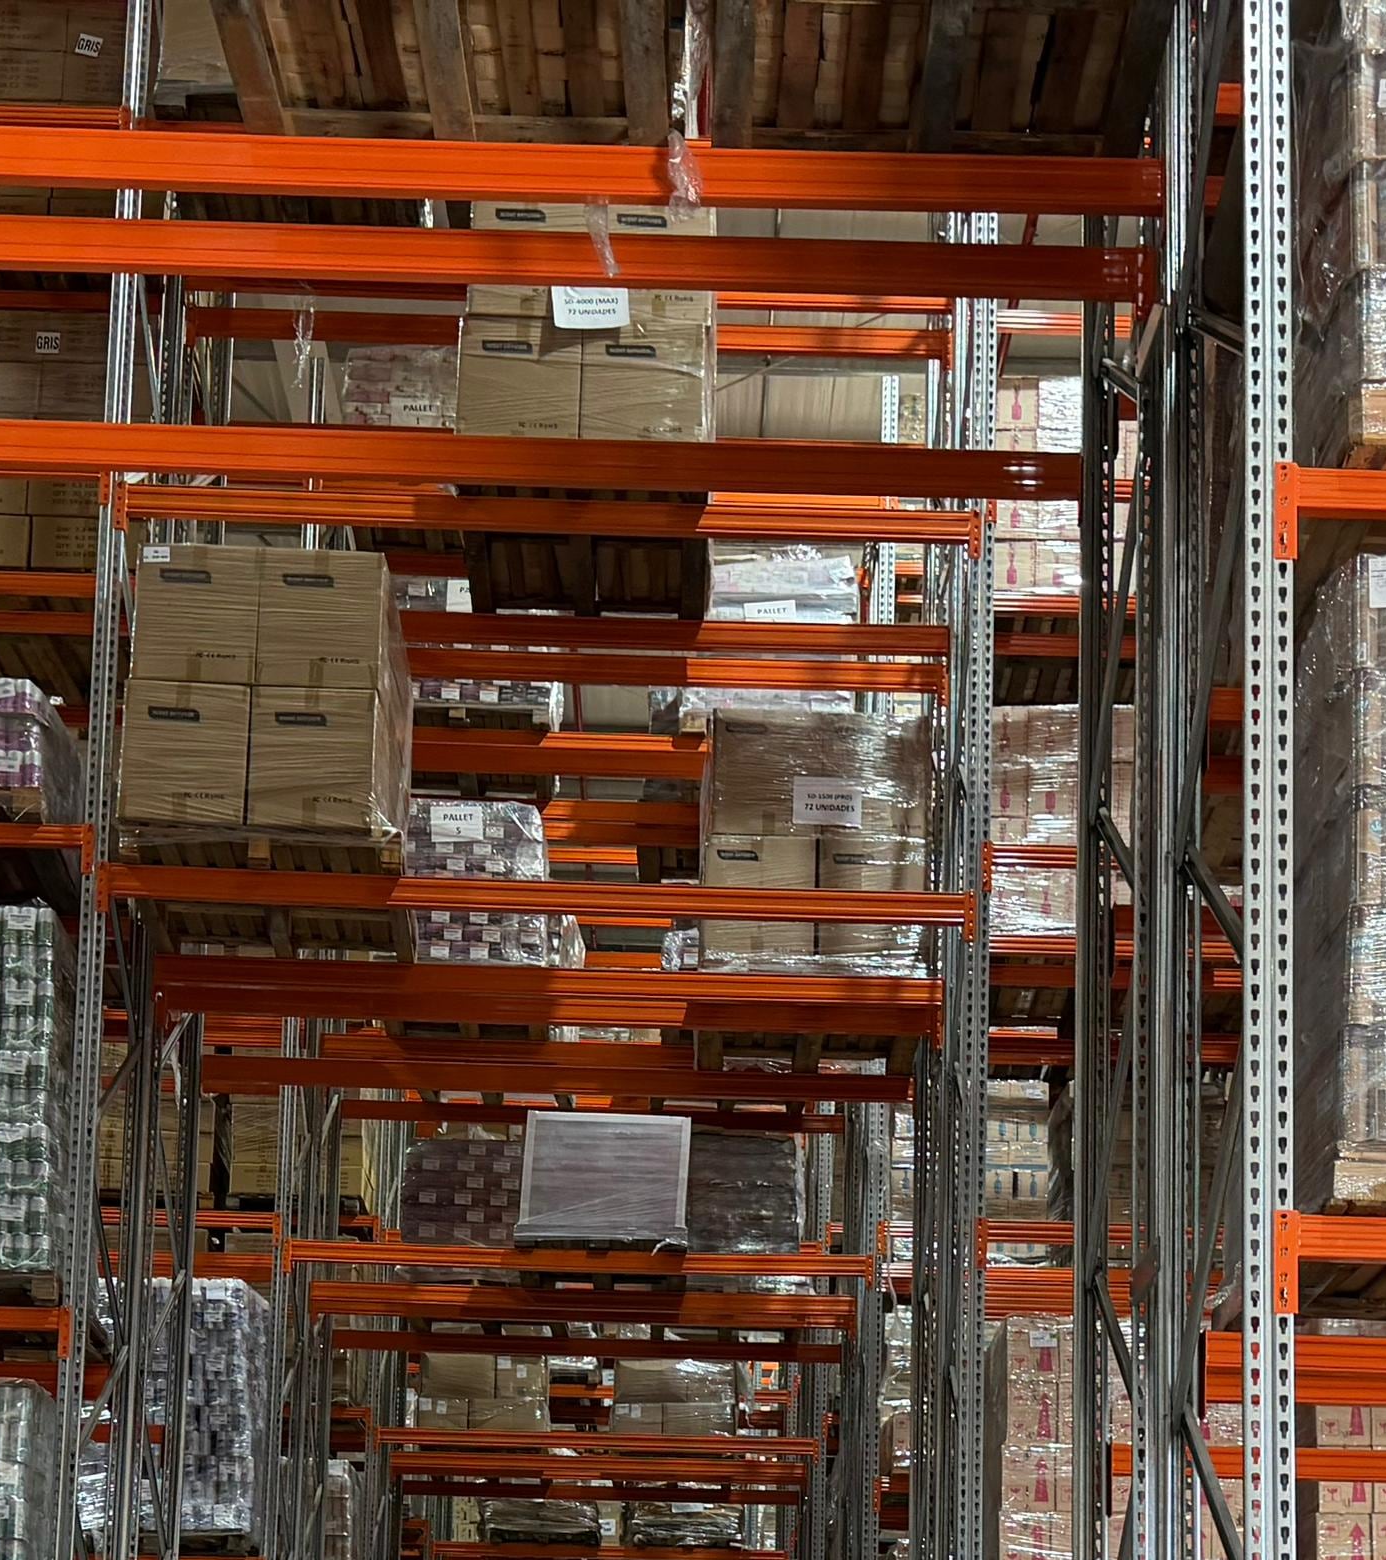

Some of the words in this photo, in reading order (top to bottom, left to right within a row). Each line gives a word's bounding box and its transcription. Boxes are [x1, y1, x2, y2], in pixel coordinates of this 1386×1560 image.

[77, 38, 101, 53] GRIS
[578, 308, 617, 316] UNIDADES
[36, 335, 60, 350] GRIS
[403, 403, 433, 414] PALLET
[756, 607, 788, 616] PALLET
[804, 803, 815, 812] 72
[816, 803, 856, 813] UNIDADES
[443, 812, 474, 823] PALLET
